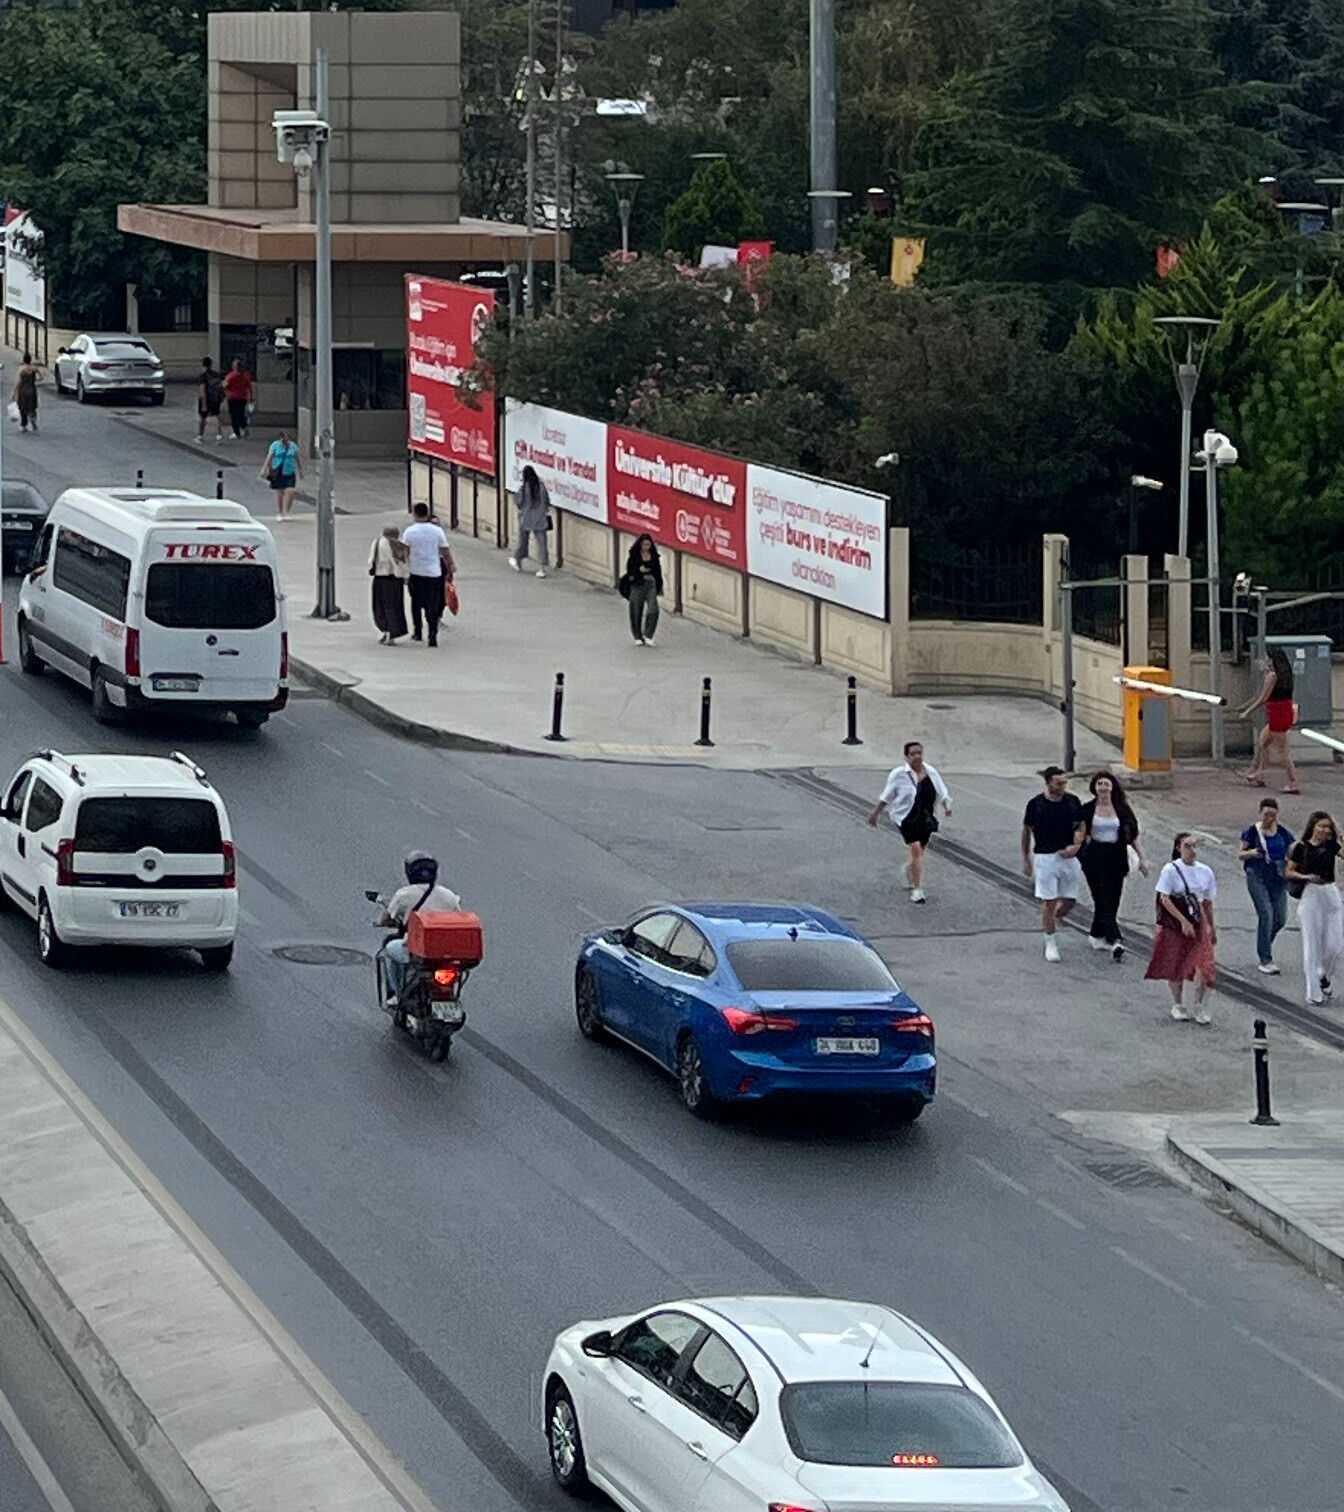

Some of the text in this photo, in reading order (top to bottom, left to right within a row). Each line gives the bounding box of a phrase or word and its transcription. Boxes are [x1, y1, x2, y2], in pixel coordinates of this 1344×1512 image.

[165, 543, 260, 561] TUREX
[787, 521, 811, 552] burs
[814, 535, 826, 556] ve
[828, 531, 872, 570] indirim
